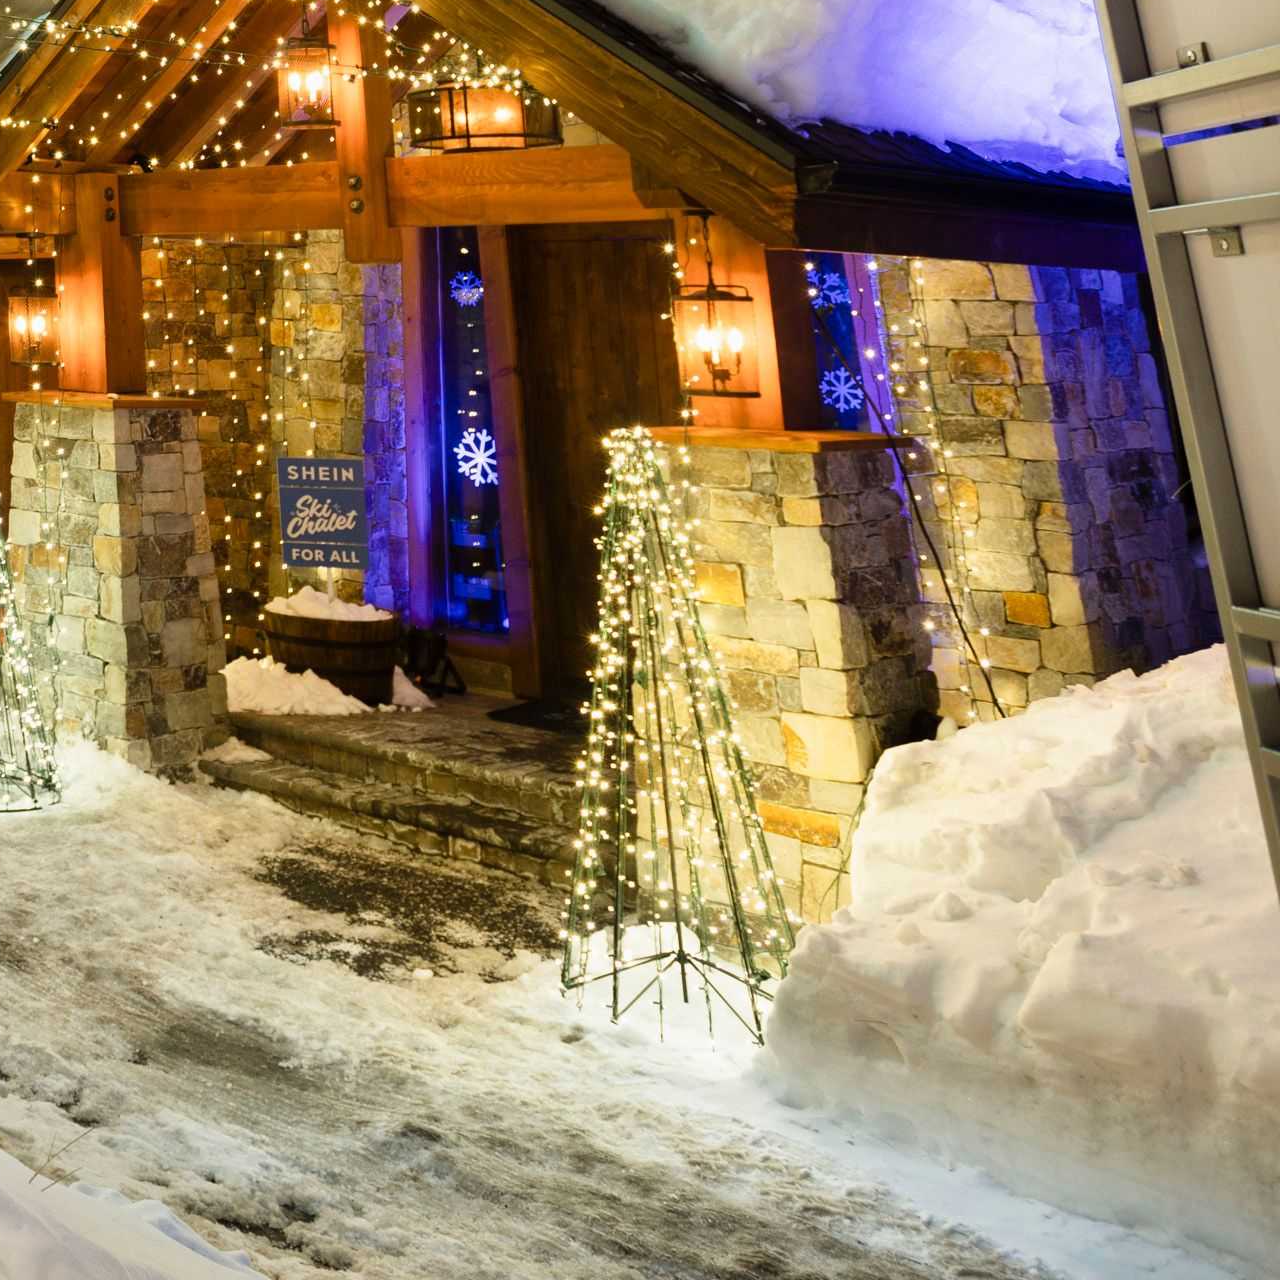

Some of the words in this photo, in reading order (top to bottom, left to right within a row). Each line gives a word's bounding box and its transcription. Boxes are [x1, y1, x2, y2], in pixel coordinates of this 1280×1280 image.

[287, 465, 355, 482] SHEIN
[295, 494, 332, 518] Ski
[286, 509, 358, 538] Chalet
[291, 548, 324, 562] FOR
[330, 549, 360, 563] ALL
